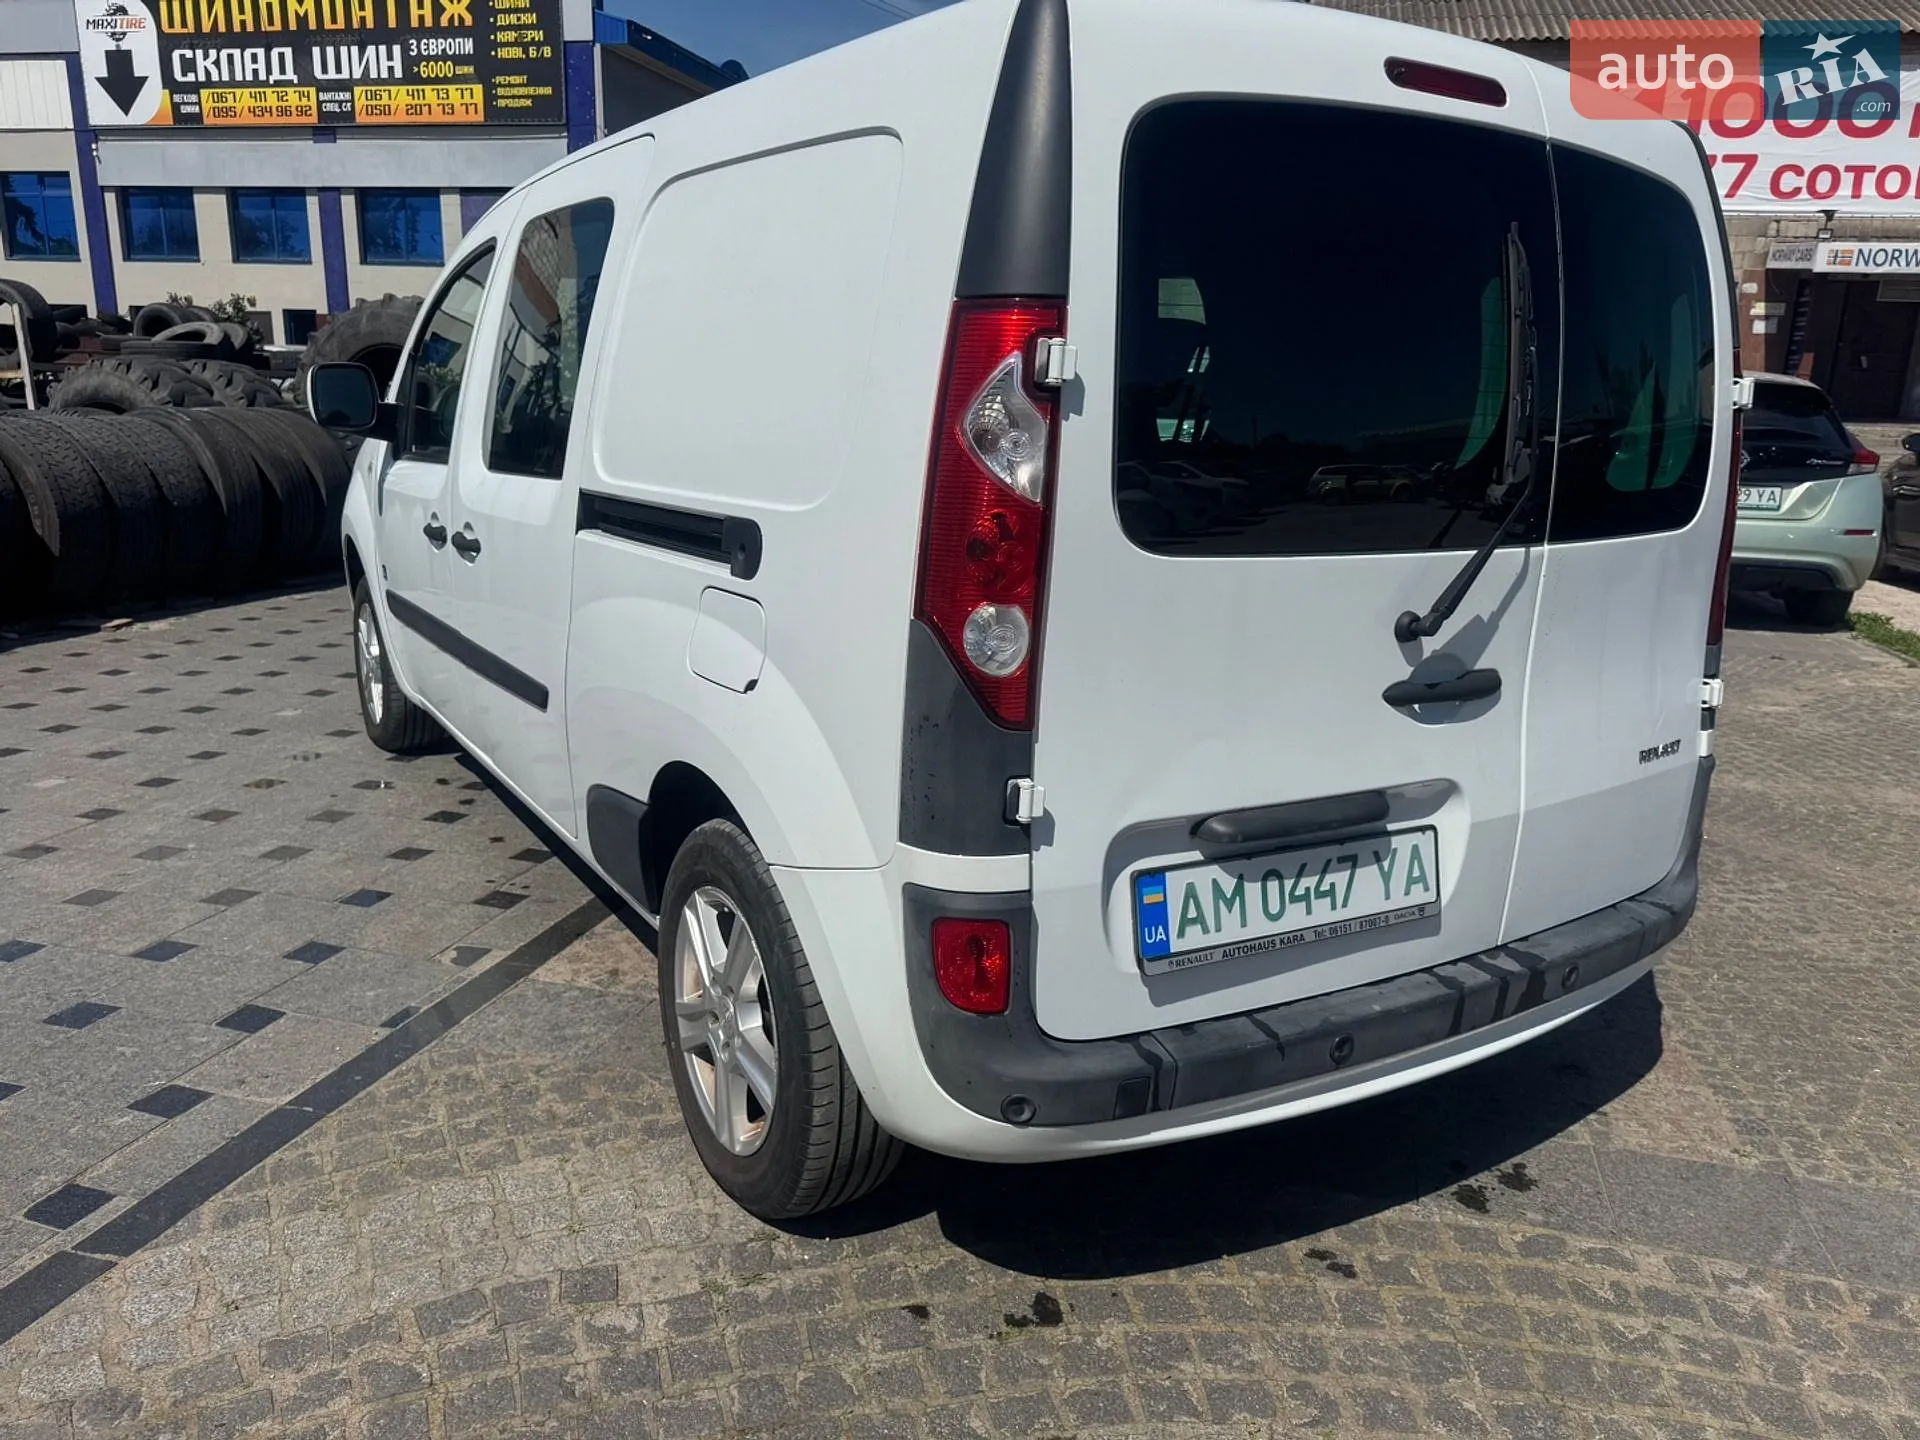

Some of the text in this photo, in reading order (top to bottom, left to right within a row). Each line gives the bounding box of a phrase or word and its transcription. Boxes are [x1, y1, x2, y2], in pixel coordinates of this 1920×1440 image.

[86, 16, 146, 29] MAXITIRE
[496, 13, 537, 26] ДИСКИ
[497, 30, 544, 42] КАМЕРИ
[421, 38, 474, 56] ЄВРОПИ
[171, 44, 403, 84] СКЛАД ШИН
[250, 91, 267, 103] 411
[272, 91, 289, 103] 72
[294, 90, 311, 103] 74
[406, 88, 426, 101] 411
[431, 88, 450, 101] 73
[455, 87, 474, 100] 77
[248, 105, 273, 118] 434
[276, 105, 292, 118] 96
[295, 105, 313, 117] 92
[405, 103, 432, 116] 207
[437, 103, 455, 116] 73
[460, 102, 479, 116] 77
[1757, 489, 1777, 503] YA
[1177, 843, 1430, 940] AM 0447 YA
[1144, 926, 1167, 943] UA
[1175, 951, 1215, 969] RENAULT
[1222, 939, 1277, 960] AUTOHAUS
[1279, 933, 1306, 950] KARA
